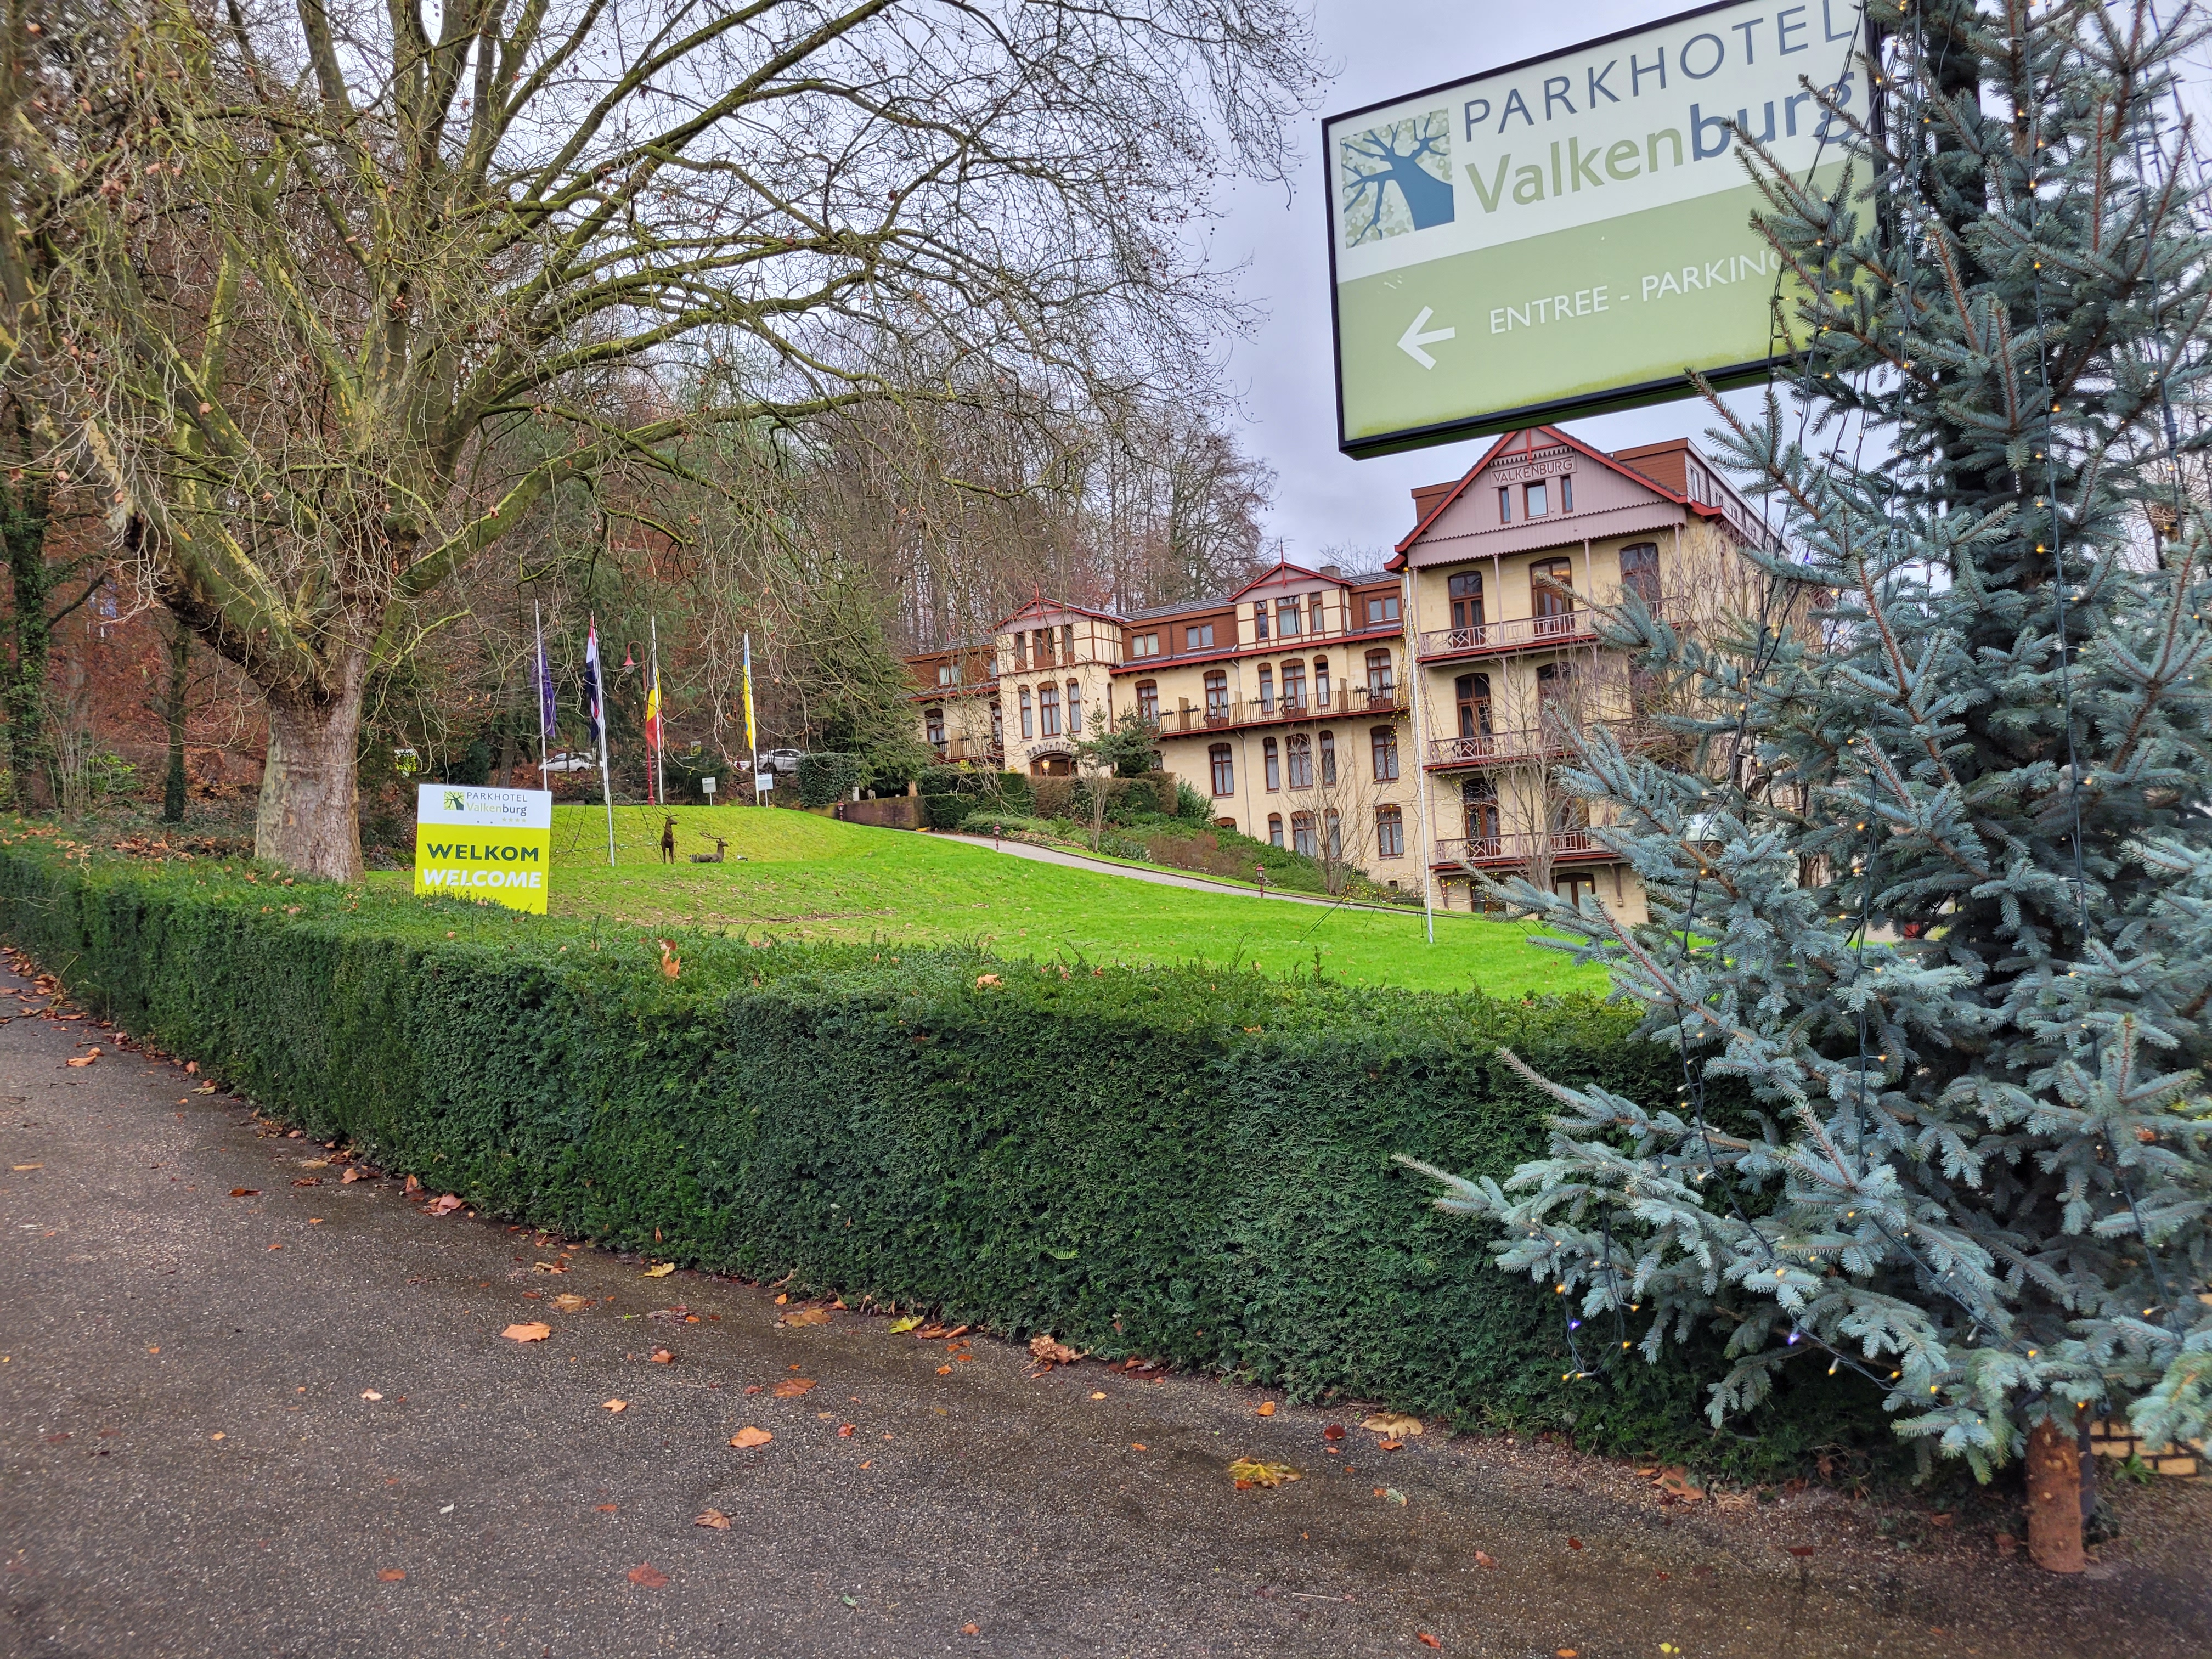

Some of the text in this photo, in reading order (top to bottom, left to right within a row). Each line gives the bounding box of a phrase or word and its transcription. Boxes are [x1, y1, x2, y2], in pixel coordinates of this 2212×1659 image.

[1464, 0, 1853, 142] PARKHOTEL
[1465, 71, 1858, 214] Valkenburg
[1489, 285, 1609, 334] ENTREE
[1493, 459, 1575, 483] VALKENBURG
[467, 792, 528, 802] PARKHOTEL
[466, 802, 527, 817] Valkenburg
[426, 843, 539, 862] WELKOM
[423, 868, 542, 888] WELCOME
